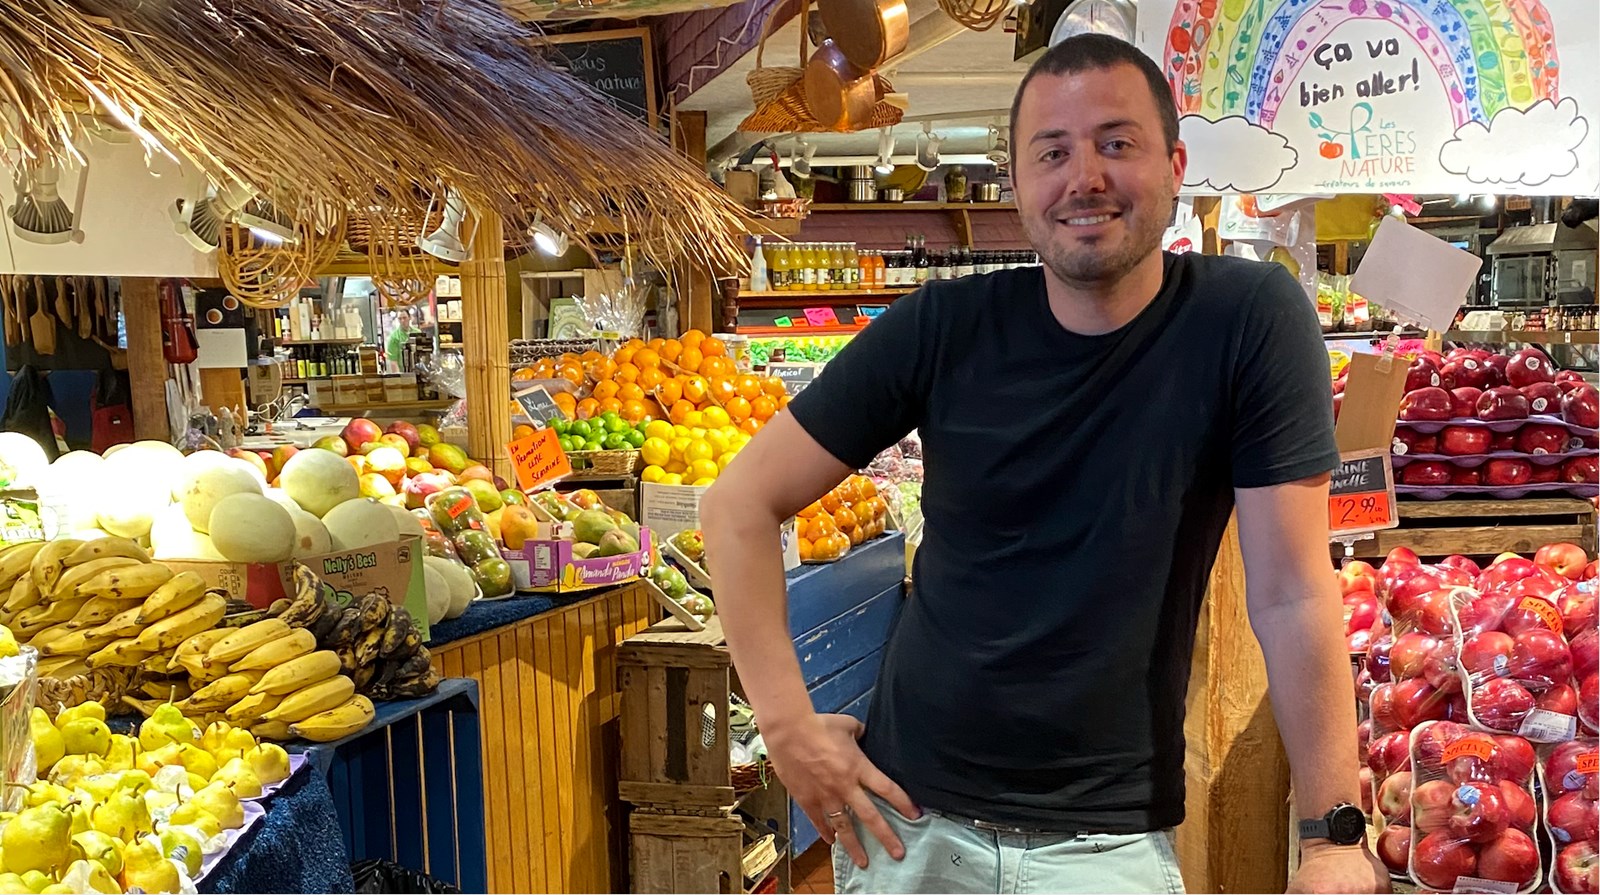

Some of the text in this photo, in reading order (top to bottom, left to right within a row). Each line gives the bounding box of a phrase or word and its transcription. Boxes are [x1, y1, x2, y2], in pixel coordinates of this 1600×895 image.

[1366, 38, 1399, 58] va
[1300, 57, 1419, 107] bien aller!
[1380, 118, 1396, 129] Les
[1340, 156, 1415, 178] NATURE
[323, 552, 377, 575] Nelly's Best
[611, 565, 635, 580] Panda
